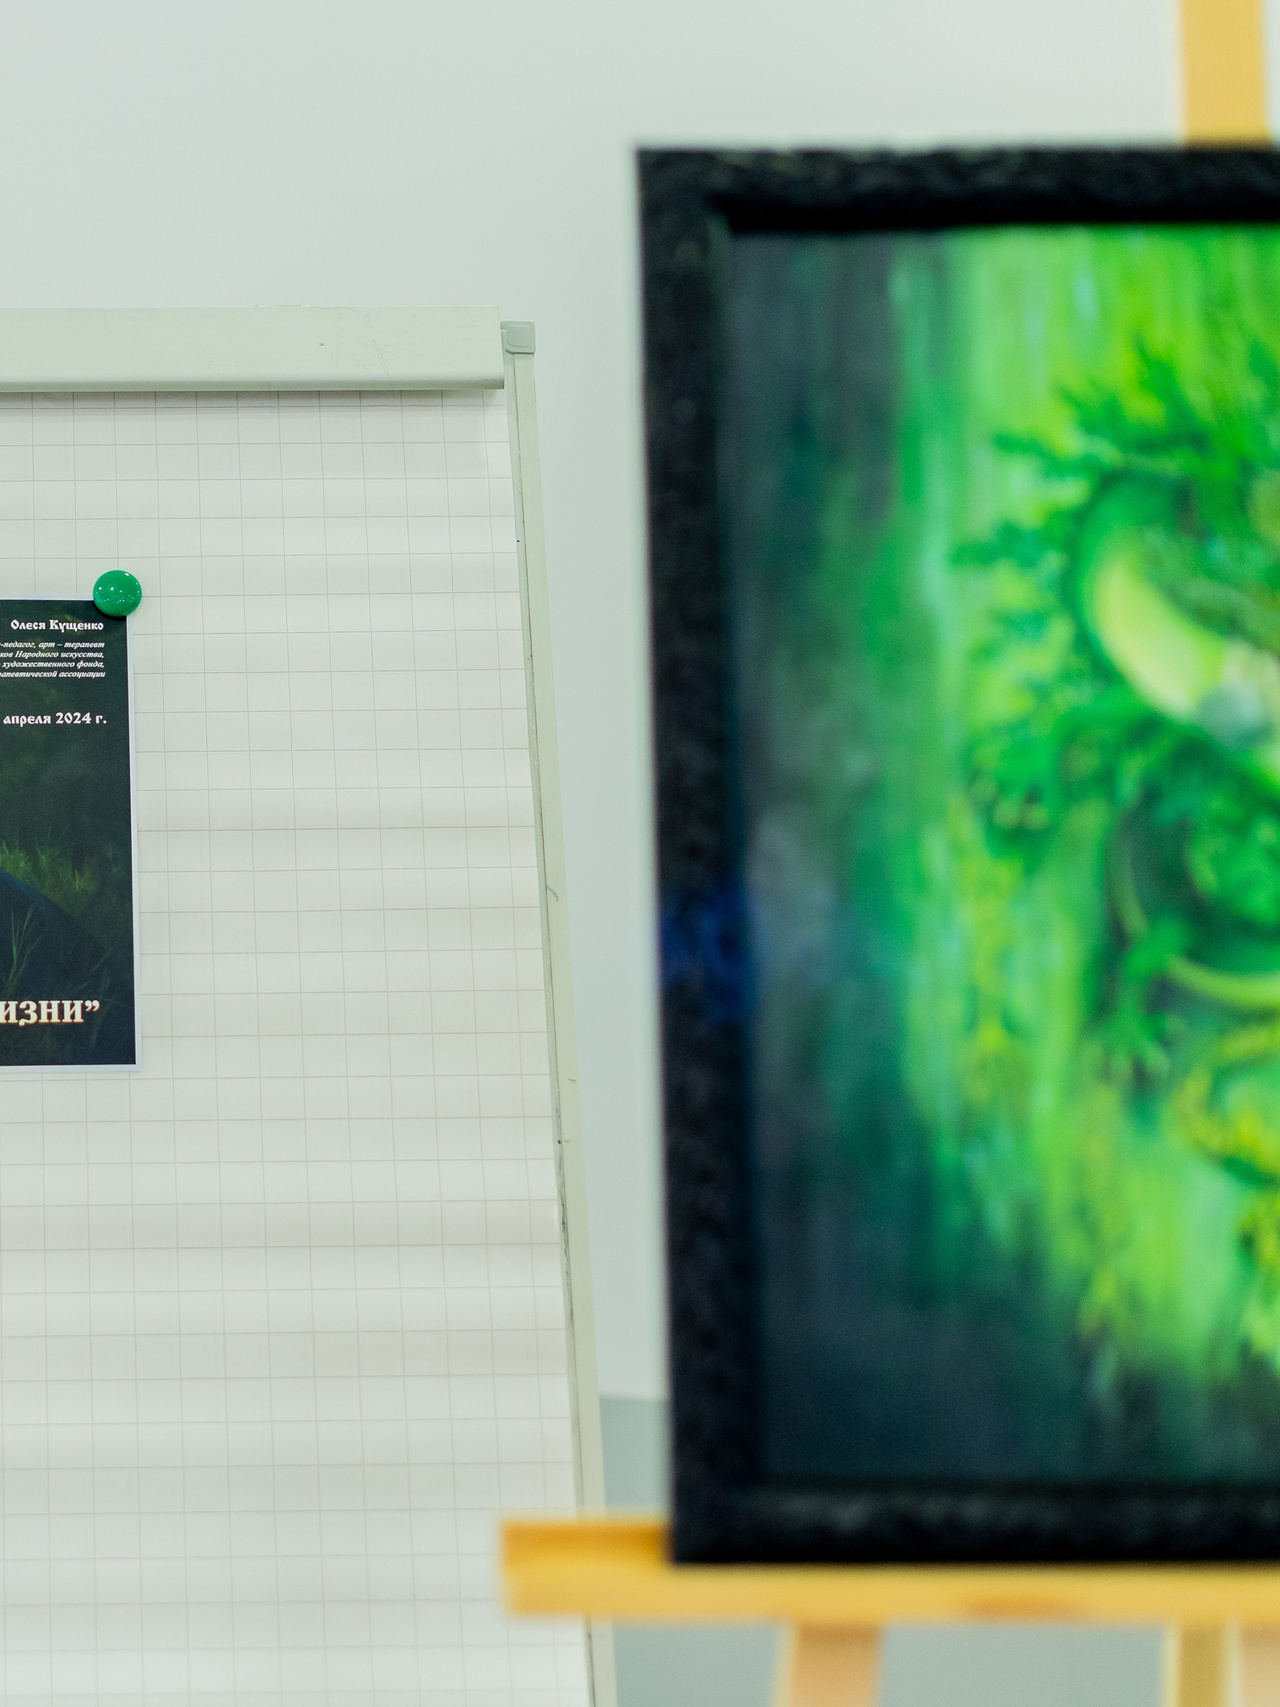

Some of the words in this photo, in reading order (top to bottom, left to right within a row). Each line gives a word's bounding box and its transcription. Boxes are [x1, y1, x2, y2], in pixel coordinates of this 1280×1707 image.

[10, 619, 46, 630] Олеся
[49, 619, 104, 633] Кущенко
[64, 642, 105, 650] терапевт
[15, 651, 59, 659] Народного
[1, 661, 75, 669] художественного
[76, 660, 105, 669] фонда,
[3, 713, 51, 727] апреля
[55, 712, 92, 725] 2024
[95, 714, 107, 724] г.
